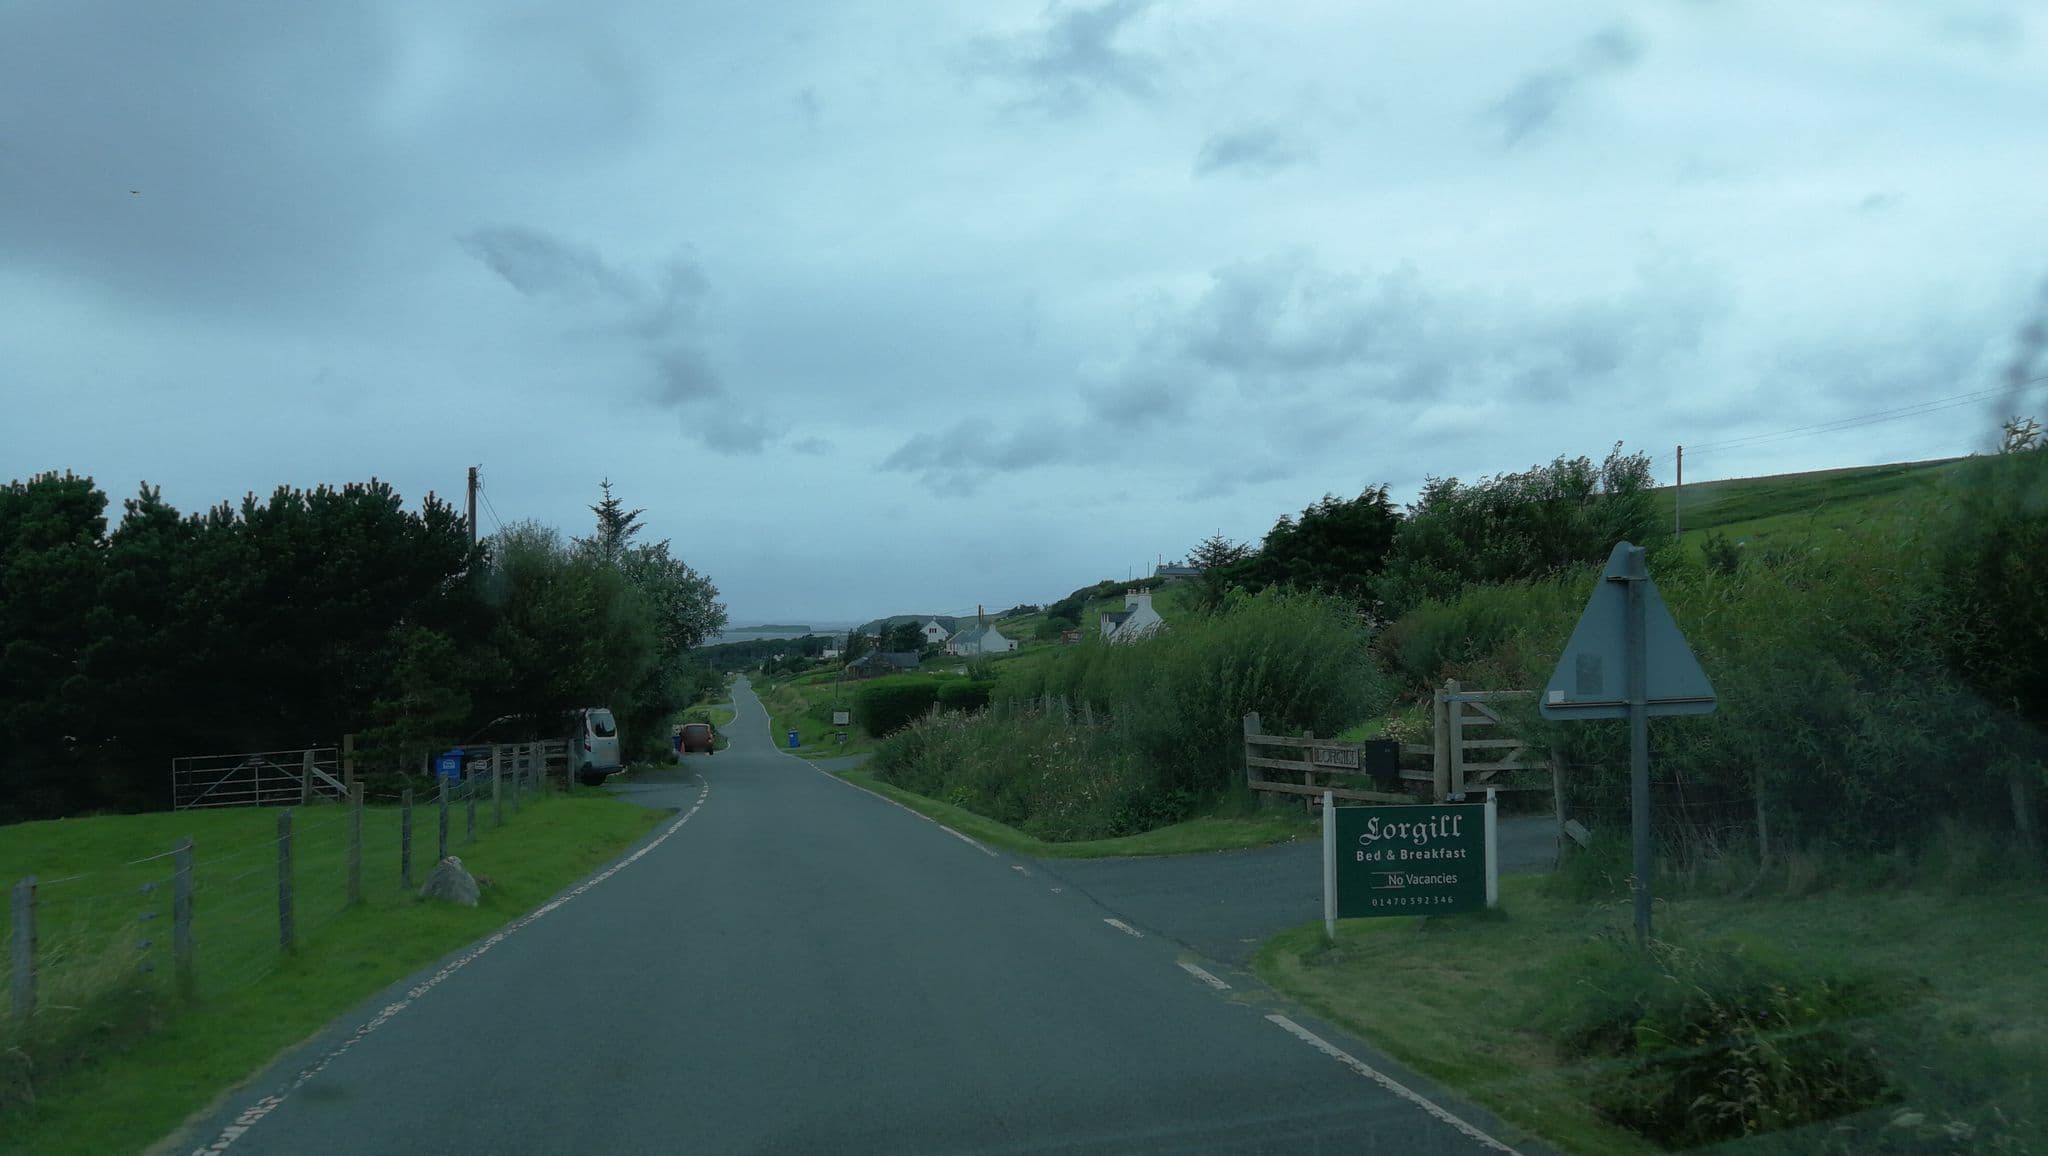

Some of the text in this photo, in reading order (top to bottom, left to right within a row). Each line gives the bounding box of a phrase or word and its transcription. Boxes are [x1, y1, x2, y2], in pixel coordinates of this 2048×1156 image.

[1359, 814, 1463, 846] Lorgill
[1356, 848, 1466, 862] Bed & Breakfast
[1388, 873, 1458, 886] No Vacancies
[1372, 895, 1454, 907] 01470 592 346
